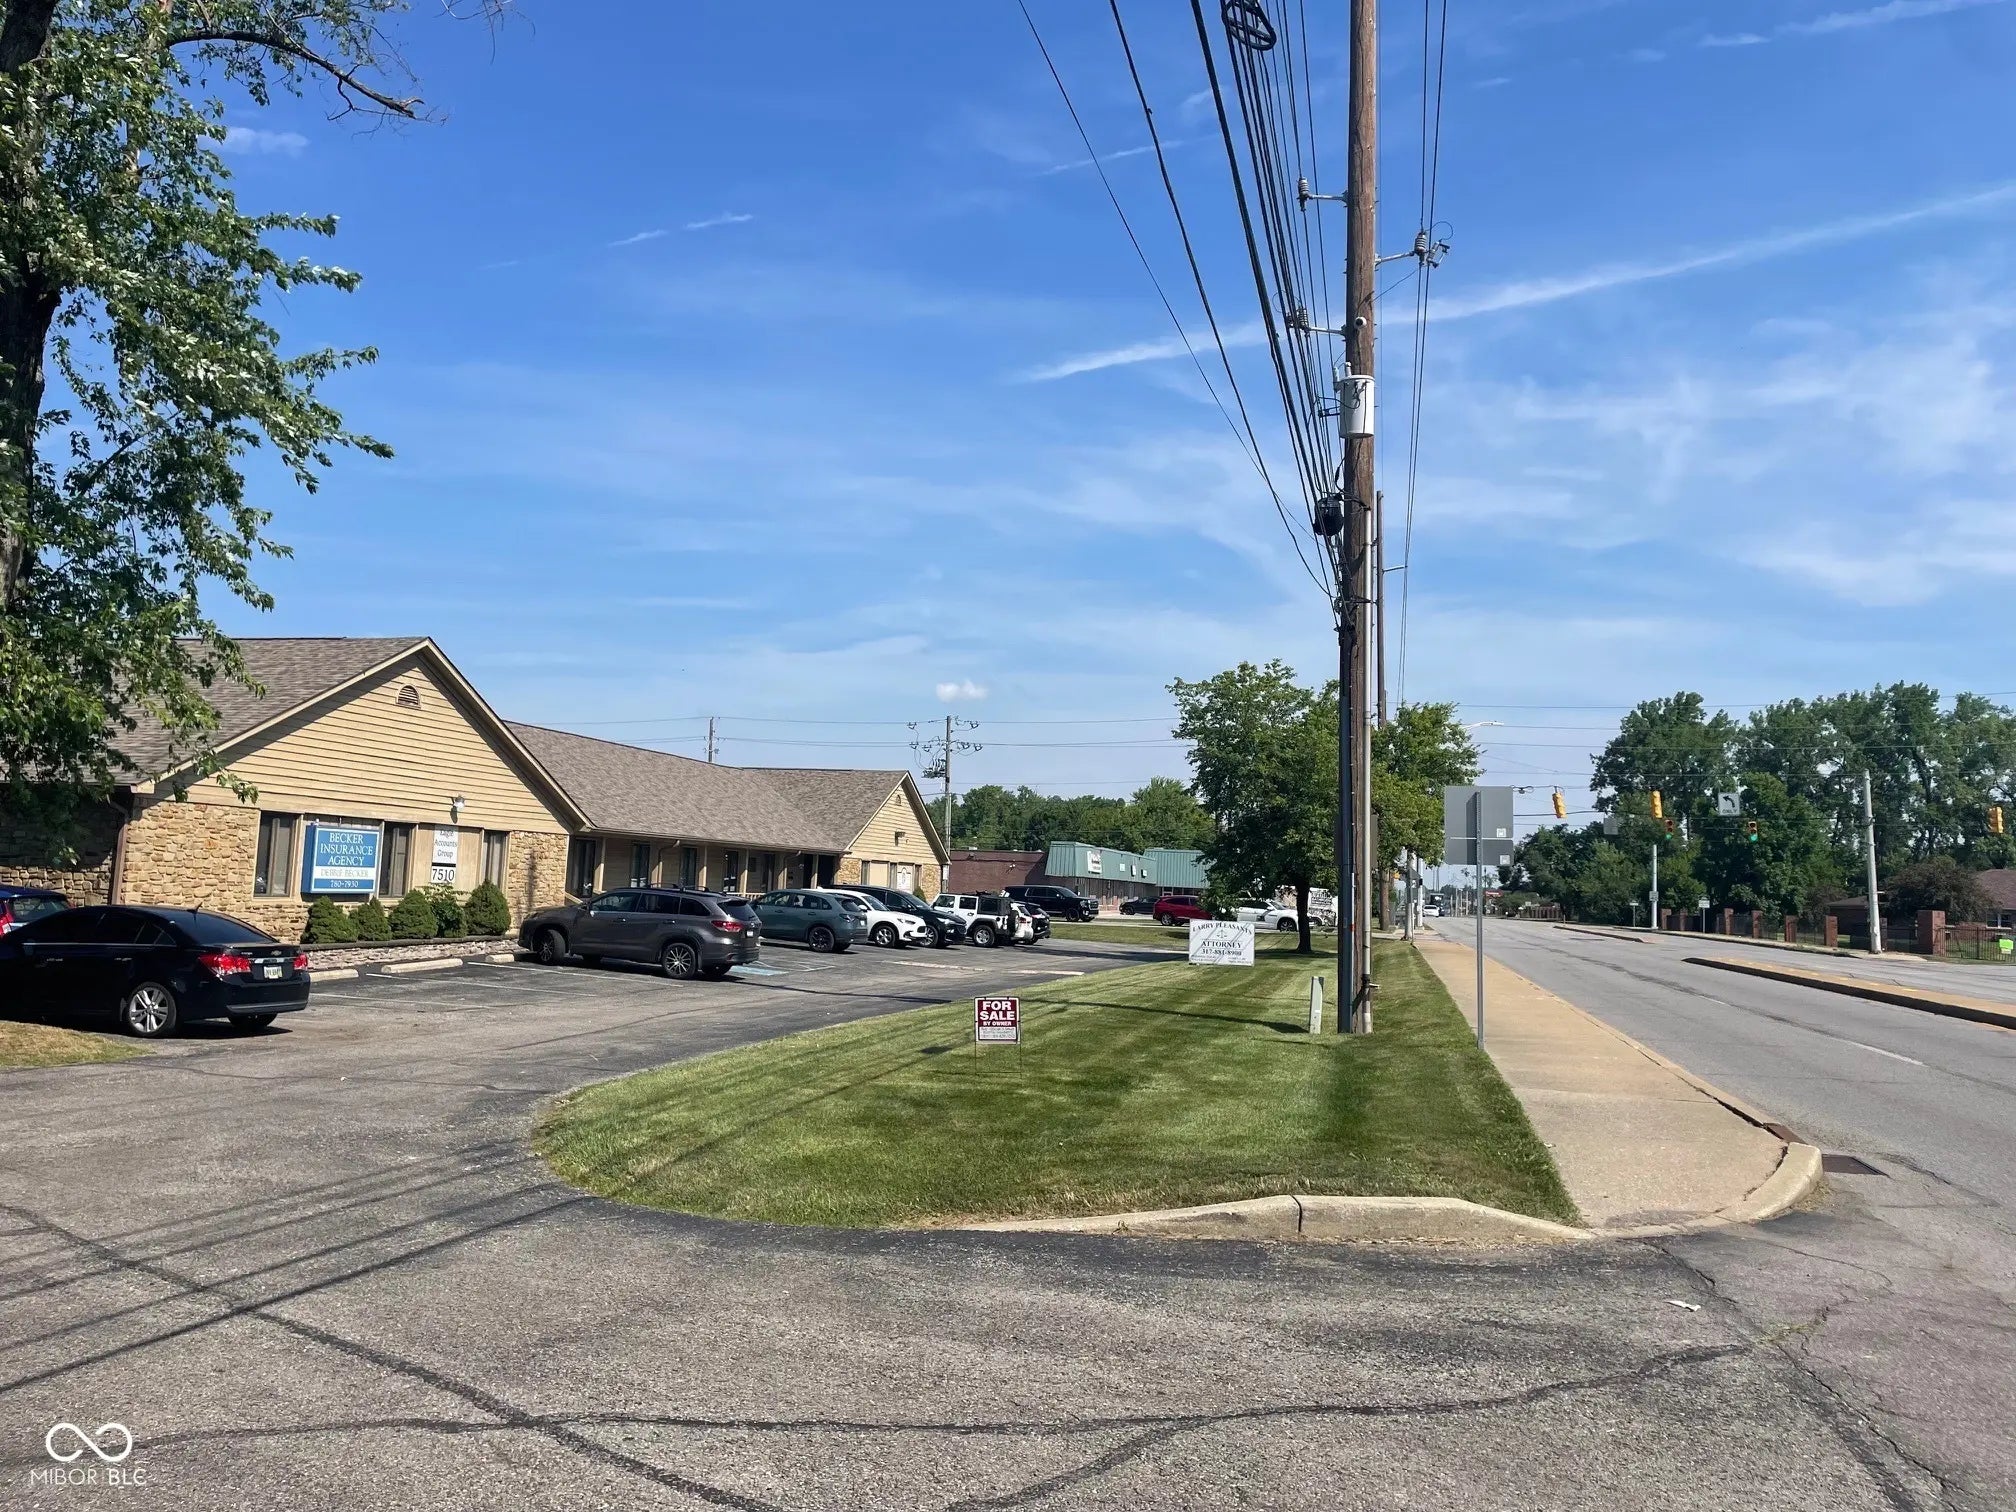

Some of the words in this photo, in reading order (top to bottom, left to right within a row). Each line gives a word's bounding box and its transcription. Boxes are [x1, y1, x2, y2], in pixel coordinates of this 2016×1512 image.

[330, 832, 364, 844] BECKER
[320, 843, 374, 855] INSURANCE
[437, 850, 454, 858] Group
[328, 855, 365, 866] AGENCY
[344, 870, 368, 878] BECKER
[432, 868, 454, 882] 7510
[330, 880, 358, 888] 780-7930
[1202, 940, 1242, 948] ATTORNEY
[982, 1001, 1012, 1010] FOR
[980, 1011, 1016, 1020] SALE
